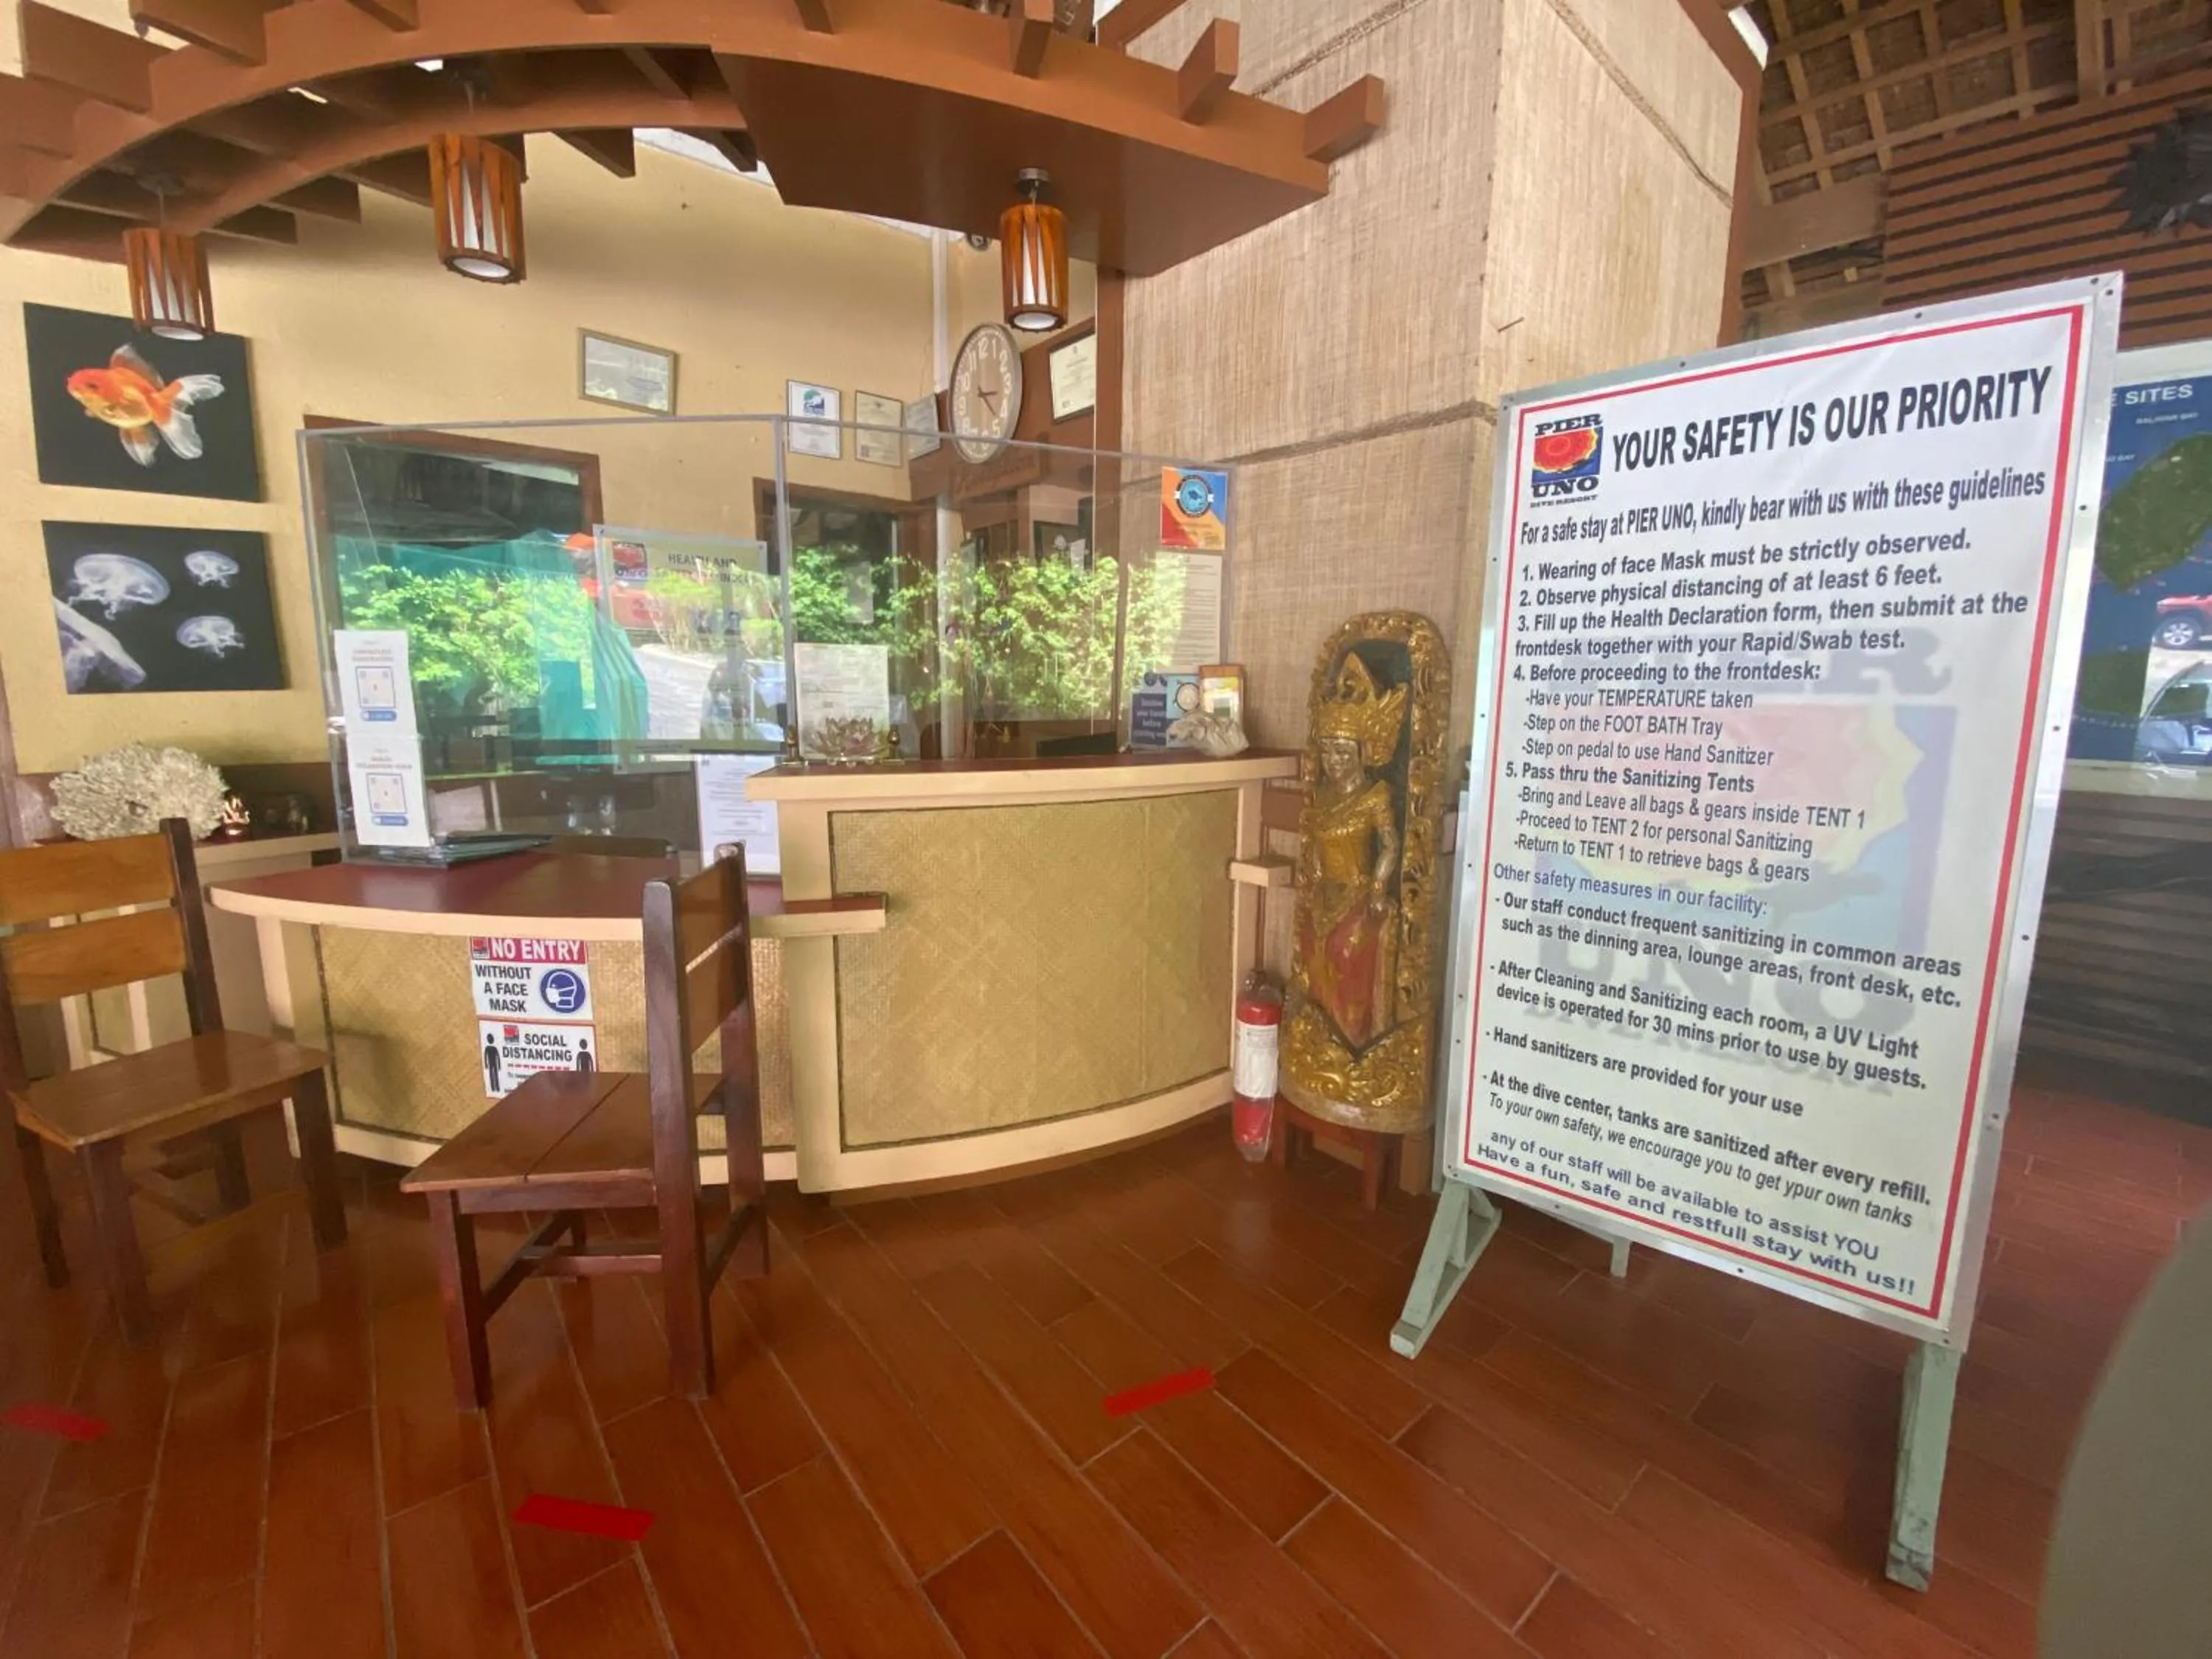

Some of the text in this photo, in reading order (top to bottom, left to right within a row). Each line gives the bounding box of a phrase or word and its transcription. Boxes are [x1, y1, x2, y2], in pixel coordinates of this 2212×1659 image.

[978, 337, 989, 360] 12
[992, 339, 996, 359] 1
[969, 349, 978, 373] 11
[999, 349, 1008, 373] 2
[1004, 372, 1012, 395] 3
[2125, 384, 2194, 405] SITES
[1000, 398, 1007, 418] 4
[1613, 366, 2053, 472] YOUR SAFETY IS OUR PRIORITY
[992, 419, 1001, 438] 5
[1535, 414, 1602, 437] PIER
[1531, 476, 1599, 498] UNO
[1521, 467, 2045, 545] For a safe stay at PIER UNO, kindly bear with us with these guidelines
[1523, 527, 1970, 581] 1. Wearing of face Mask must be strictly observed.
[1519, 563, 1941, 607] 2. Observe physical distancing of at least 6 feet.
[1517, 591, 2028, 634] 3. Fill up the Health Declaration form, then submit at the
[1516, 629, 1905, 659] frontdesk together with your Rapid/Swab test.
[1513, 661, 1820, 684] 4. Before proceeding to the frontdesk:
[1565, 693, 1594, 710] your
[1598, 689, 1706, 708] TEMPERATURE
[1711, 690, 1753, 708] taken
[1559, 718, 1575, 731] on
[1580, 715, 1600, 731] the
[1604, 715, 1644, 733] FOOT
[1647, 716, 1687, 734] BATH
[1691, 717, 1722, 740] Tray
[1506, 761, 1754, 793] 5. Pass thru the Sanitizing Tents
[1558, 790, 1582, 806] and
[1586, 790, 1626, 810] Leave
[1630, 795, 1646, 811] all
[1650, 795, 1684, 818] bags
[1689, 798, 1699, 815] &
[1705, 804, 1746, 822] gears
[1752, 802, 1799, 824] inside
[1806, 806, 1851, 827] TENT
[1858, 810, 1865, 830] 1
[1494, 863, 1767, 919] Other safety measures in our facility:
[1504, 892, 1961, 976] Our staff conduct frequent sanitizing in common areas
[491, 939, 581, 961] NO ENTRY
[475, 964, 532, 980] WITHOUT
[484, 982, 529, 996] A FACE
[490, 998, 527, 1013] MASK
[1498, 960, 1919, 1059] After Cleaning and Sanitizing each room, a UV Light
[524, 1034, 567, 1047] SOCIAL
[502, 1047, 573, 1062] DISTANCING
[1494, 1026, 1804, 1116] Hand sanitizers are provided for your use
[1478, 1144, 1915, 1295] Have a safe and restfull stay with us!!
